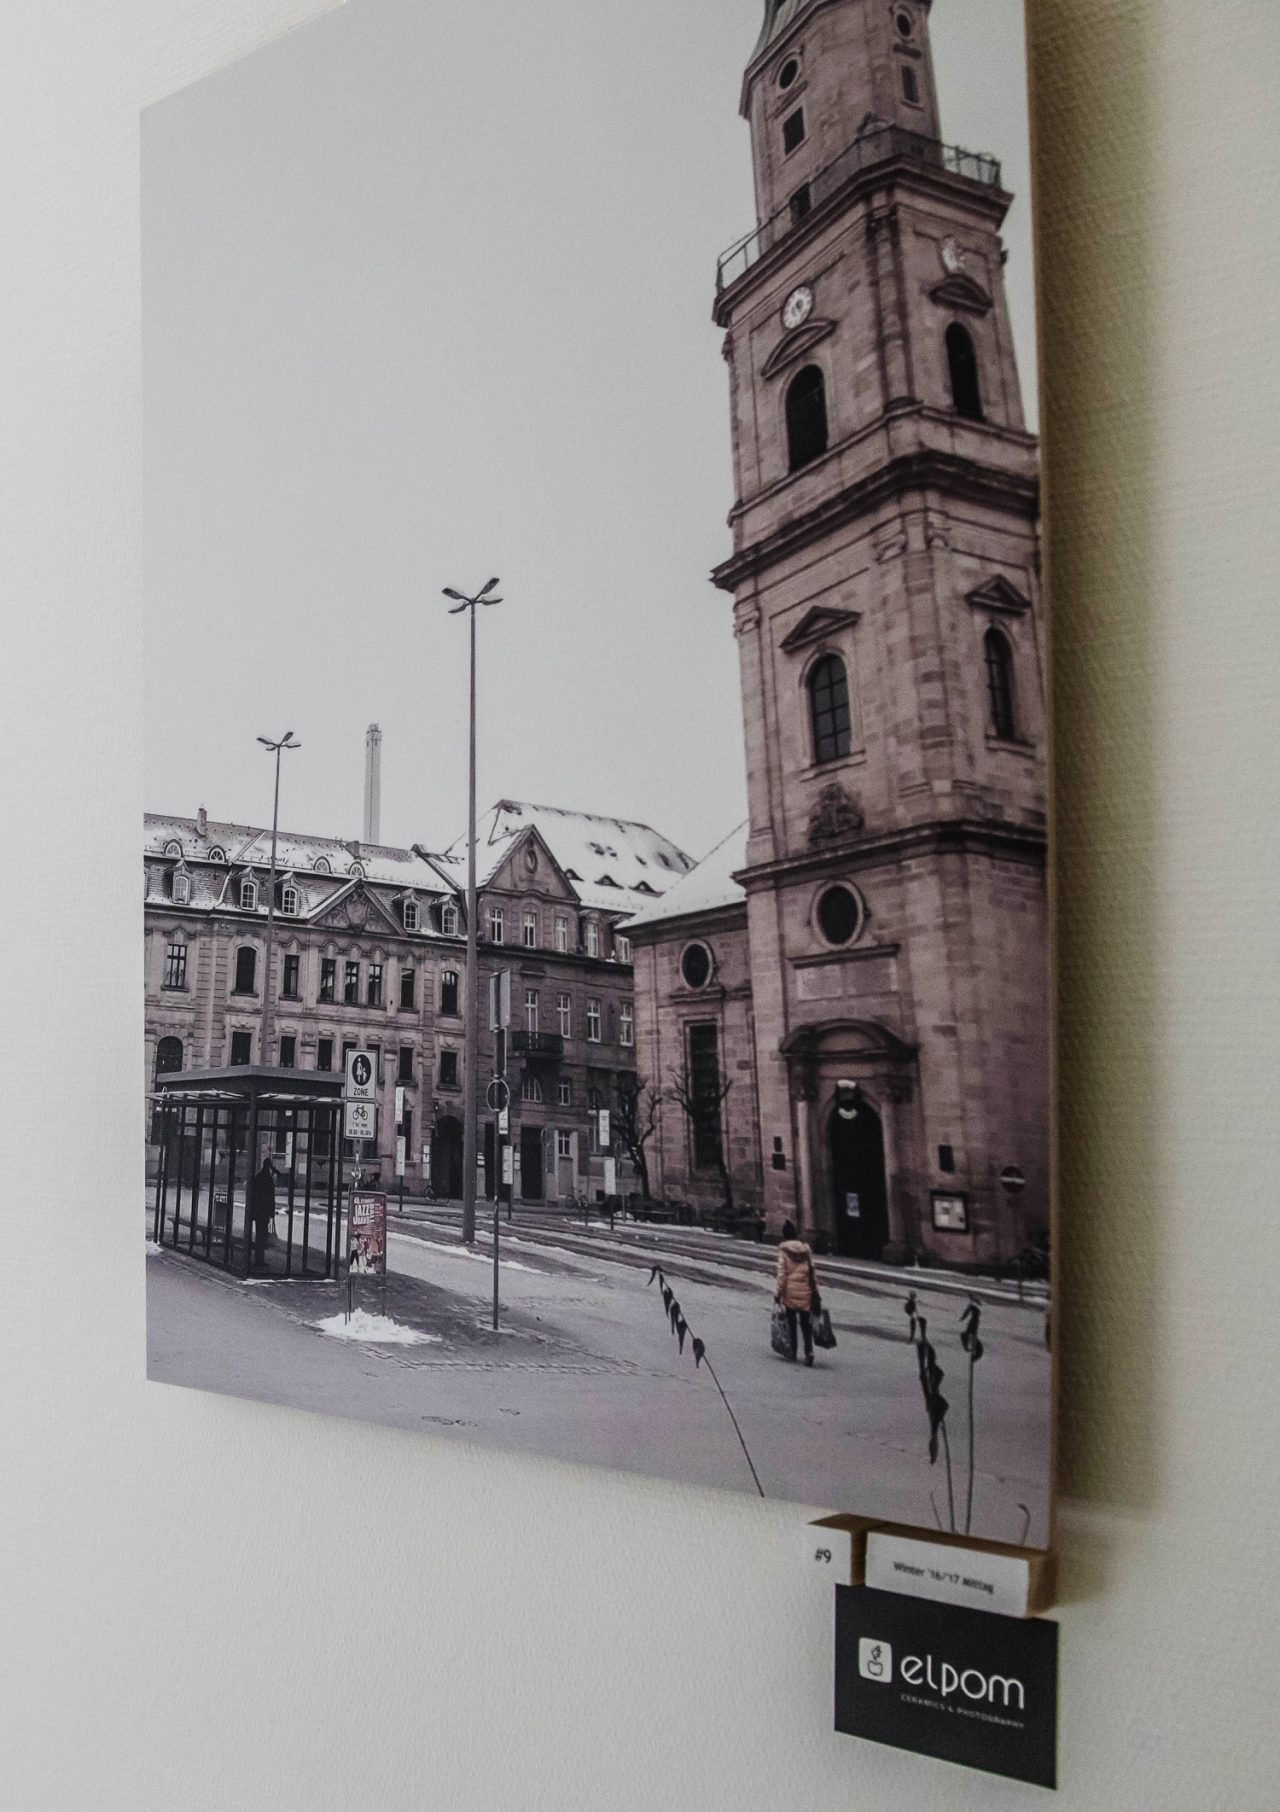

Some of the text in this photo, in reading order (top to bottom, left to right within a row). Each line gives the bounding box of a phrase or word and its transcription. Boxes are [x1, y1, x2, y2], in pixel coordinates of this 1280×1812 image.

[353, 1087, 369, 1097] ZONE
[815, 1548, 831, 1564] #9
[894, 1561, 925, 1577] Winter
[900, 1655, 1025, 1709] elpom
